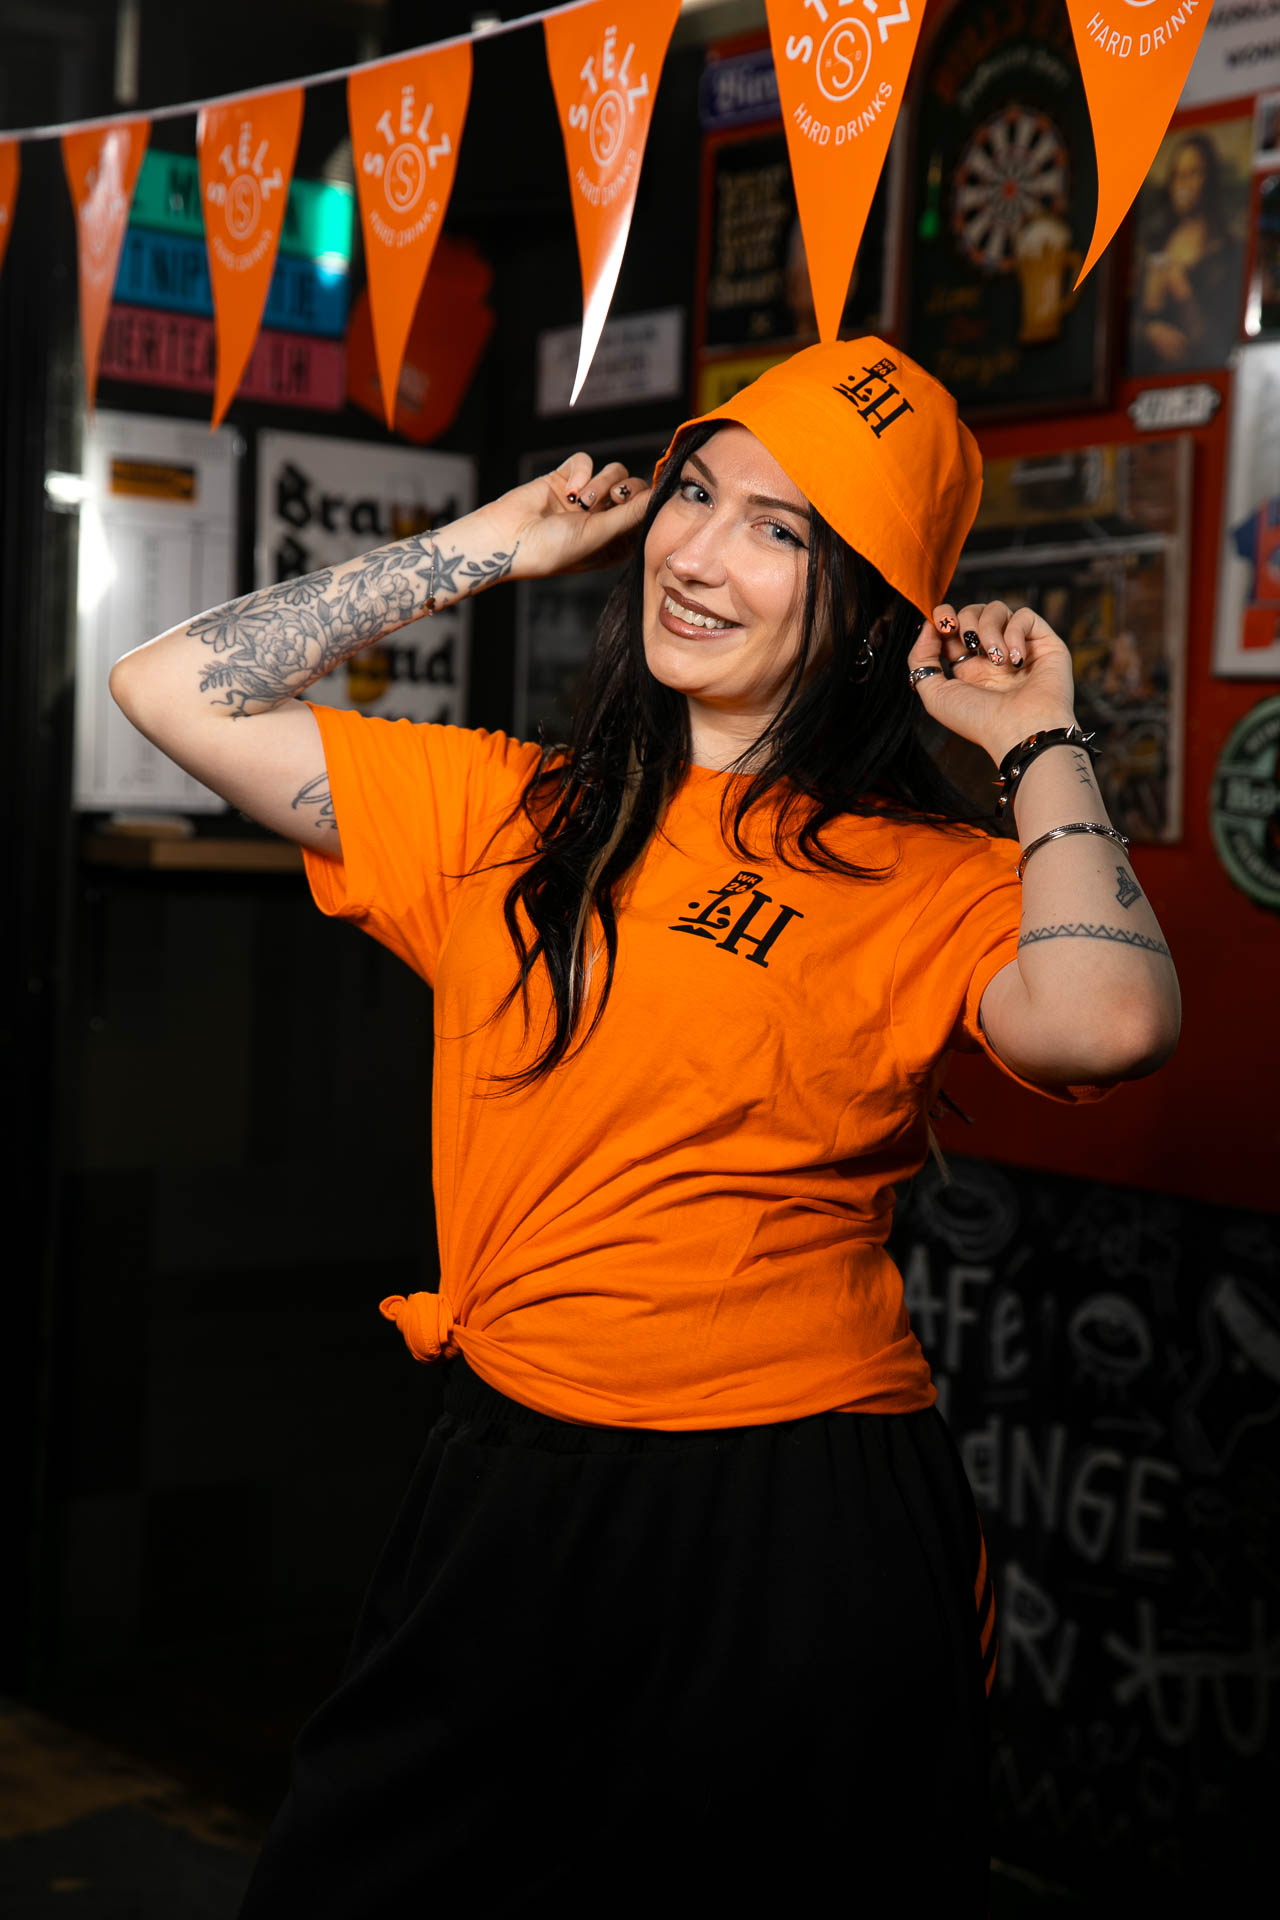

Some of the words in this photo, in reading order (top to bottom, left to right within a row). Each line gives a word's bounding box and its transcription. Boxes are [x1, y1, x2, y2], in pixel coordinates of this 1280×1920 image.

[1086, 11, 1133, 58] HARD
[1139, 0, 1200, 57] DRINK
[793, 101, 831, 147] HARD
[834, 81, 893, 147] DRINKS
[725, 882, 748, 893] 26
[737, 873, 759, 885] WK
